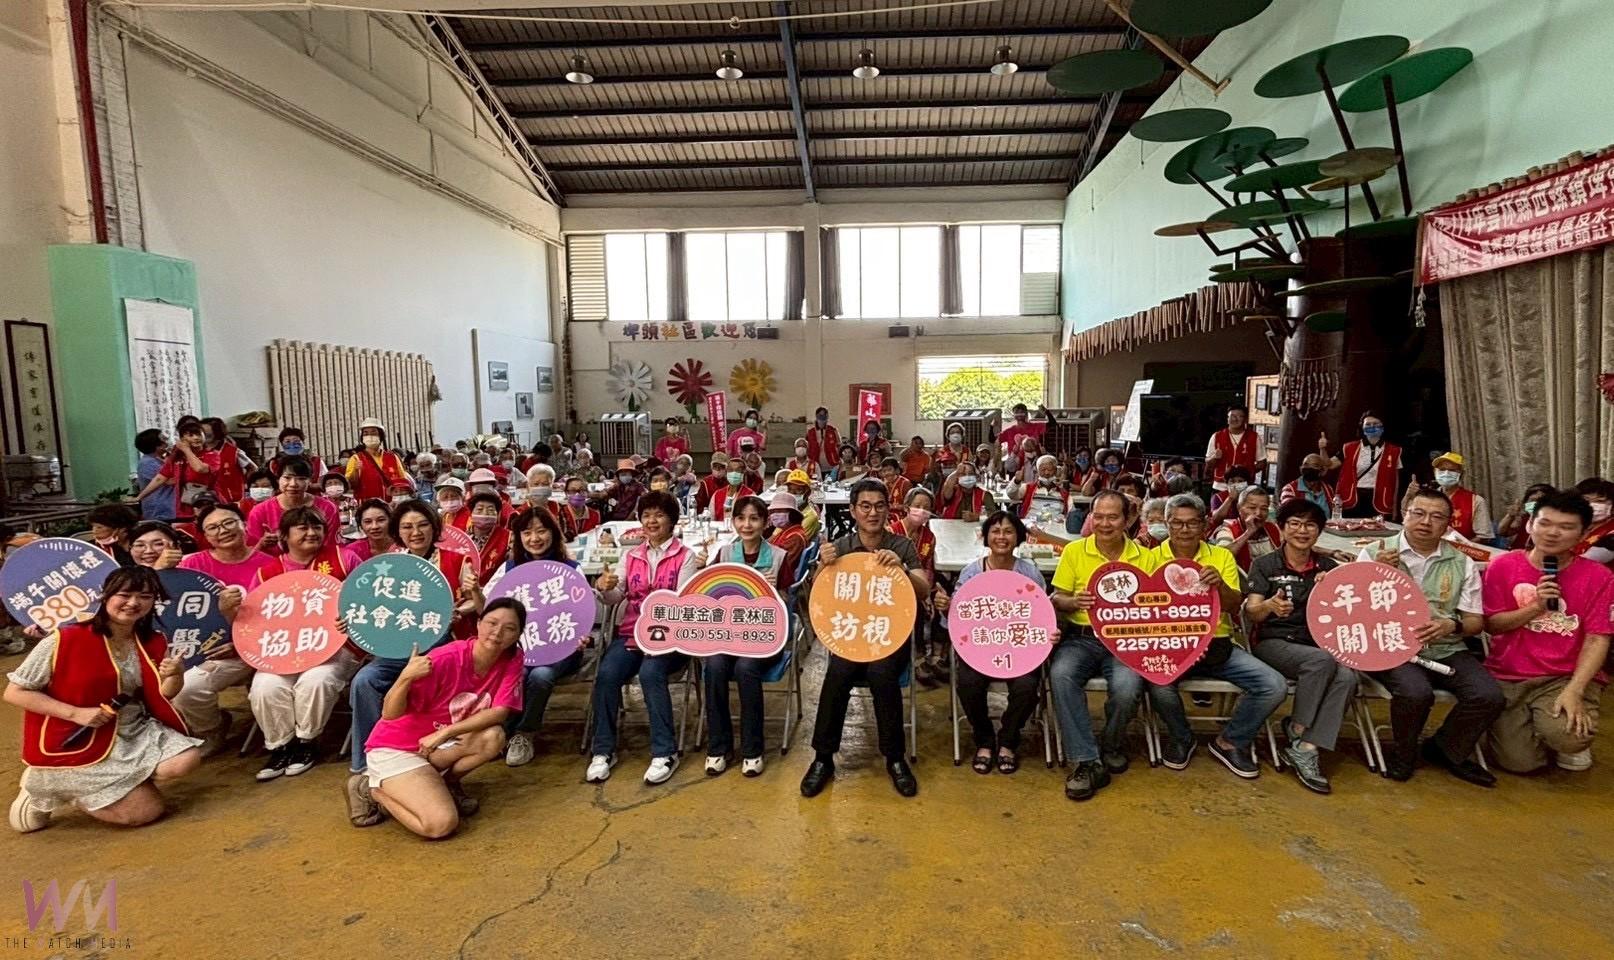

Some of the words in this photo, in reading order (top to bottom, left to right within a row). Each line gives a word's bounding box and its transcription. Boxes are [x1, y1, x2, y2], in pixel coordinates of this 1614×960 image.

[8, 550, 103, 610] 端午關懷禮
[371, 576, 422, 602] 促進
[833, 571, 896, 606] 關懷
[1101, 573, 1133, 594] 雲林
[261, 587, 332, 620] 物資
[958, 597, 1031, 620] 當我變老
[1332, 580, 1398, 616] 年節
[344, 603, 442, 635] 社會參與
[653, 606, 725, 623] 華山基金會
[732, 607, 776, 624] 雲林區
[1096, 604, 1212, 622] (05)551-8925
[258, 625, 330, 658] 協助
[518, 611, 580, 653] 服務
[674, 628, 776, 642] (05)551-8925
[830, 610, 893, 646] 訪視
[973, 622, 1047, 647] 請你愛我
[1336, 621, 1411, 654] 關懷
[1116, 636, 1200, 652] 22573817
[993, 654, 1011, 669] +1
